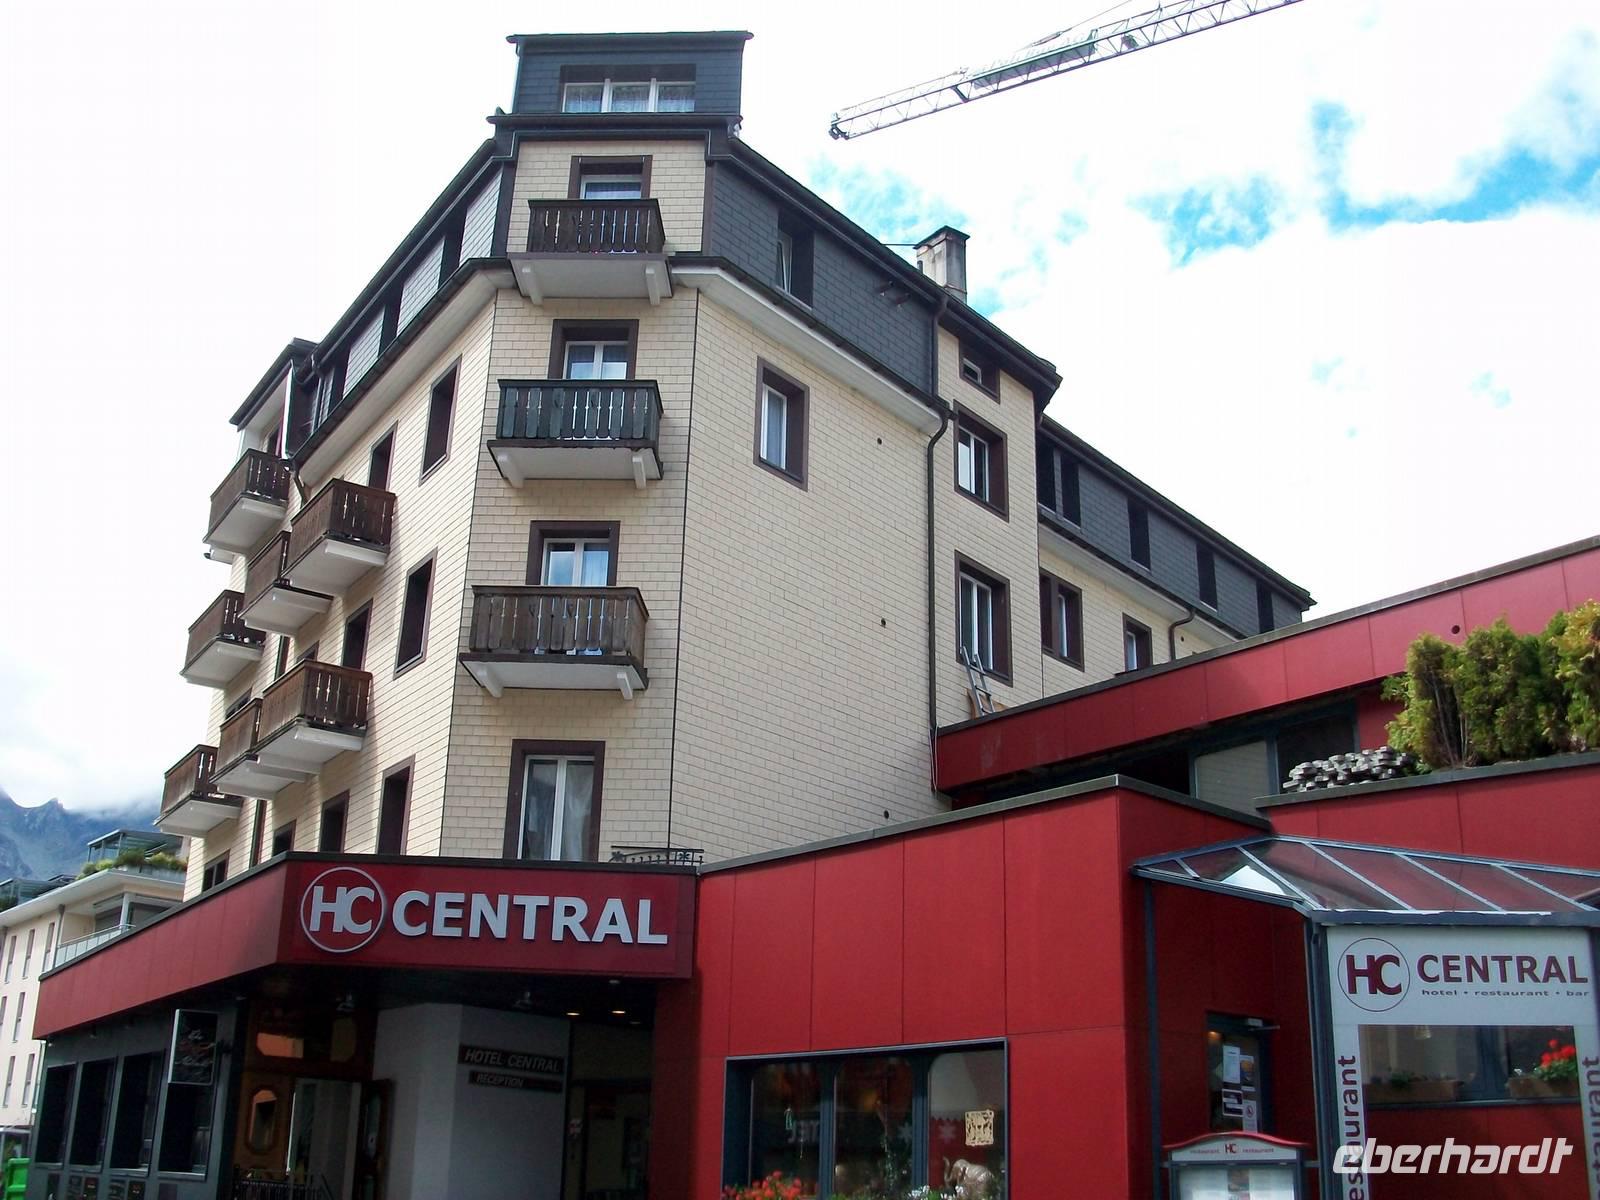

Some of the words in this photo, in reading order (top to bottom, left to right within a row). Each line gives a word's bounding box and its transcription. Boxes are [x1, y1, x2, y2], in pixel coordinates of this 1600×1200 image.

[309, 885, 375, 935] HC
[392, 890, 668, 945] CENTRAL
[1345, 954, 1403, 996] HC
[1416, 954, 1589, 984] CENTRAL
[1421, 988, 1458, 997] hotel
[1474, 989, 1549, 997] restaurant
[464, 1048, 504, 1066] HOTEL
[507, 1054, 561, 1073] CENTRAL
[476, 1072, 525, 1088] RECEPTION
[1337, 1054, 1364, 1200] estaurant
[1223, 1143, 1238, 1154] HC
